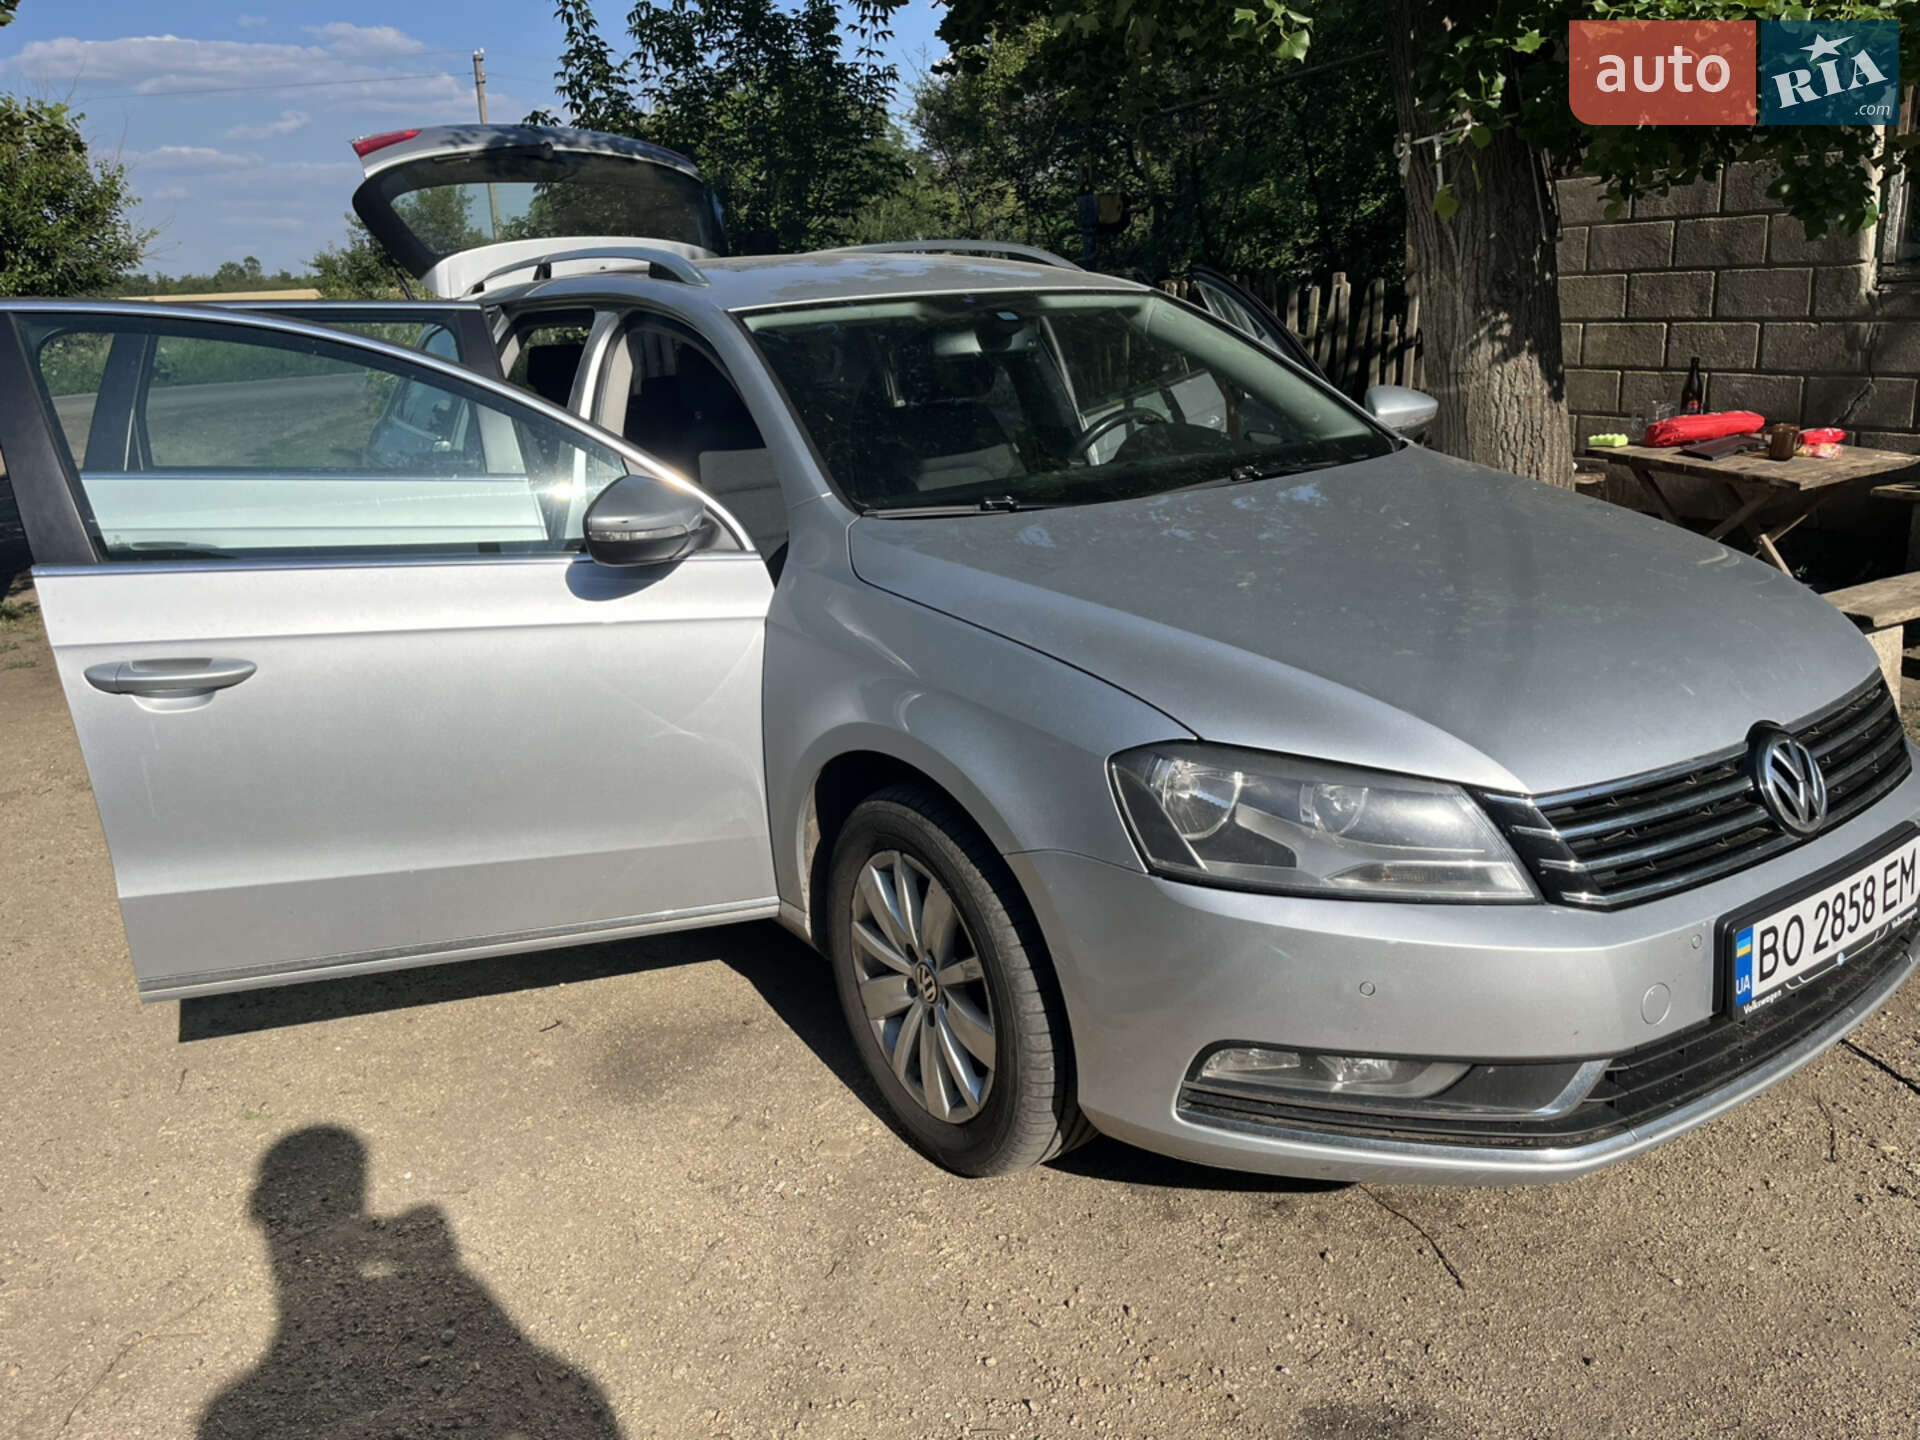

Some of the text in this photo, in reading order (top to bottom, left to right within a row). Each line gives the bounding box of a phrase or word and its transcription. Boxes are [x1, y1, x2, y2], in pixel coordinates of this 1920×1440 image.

[1761, 737, 1828, 835] VW
[1759, 848, 1917, 983] BO 2858 EM
[1736, 974, 1751, 995] UA
